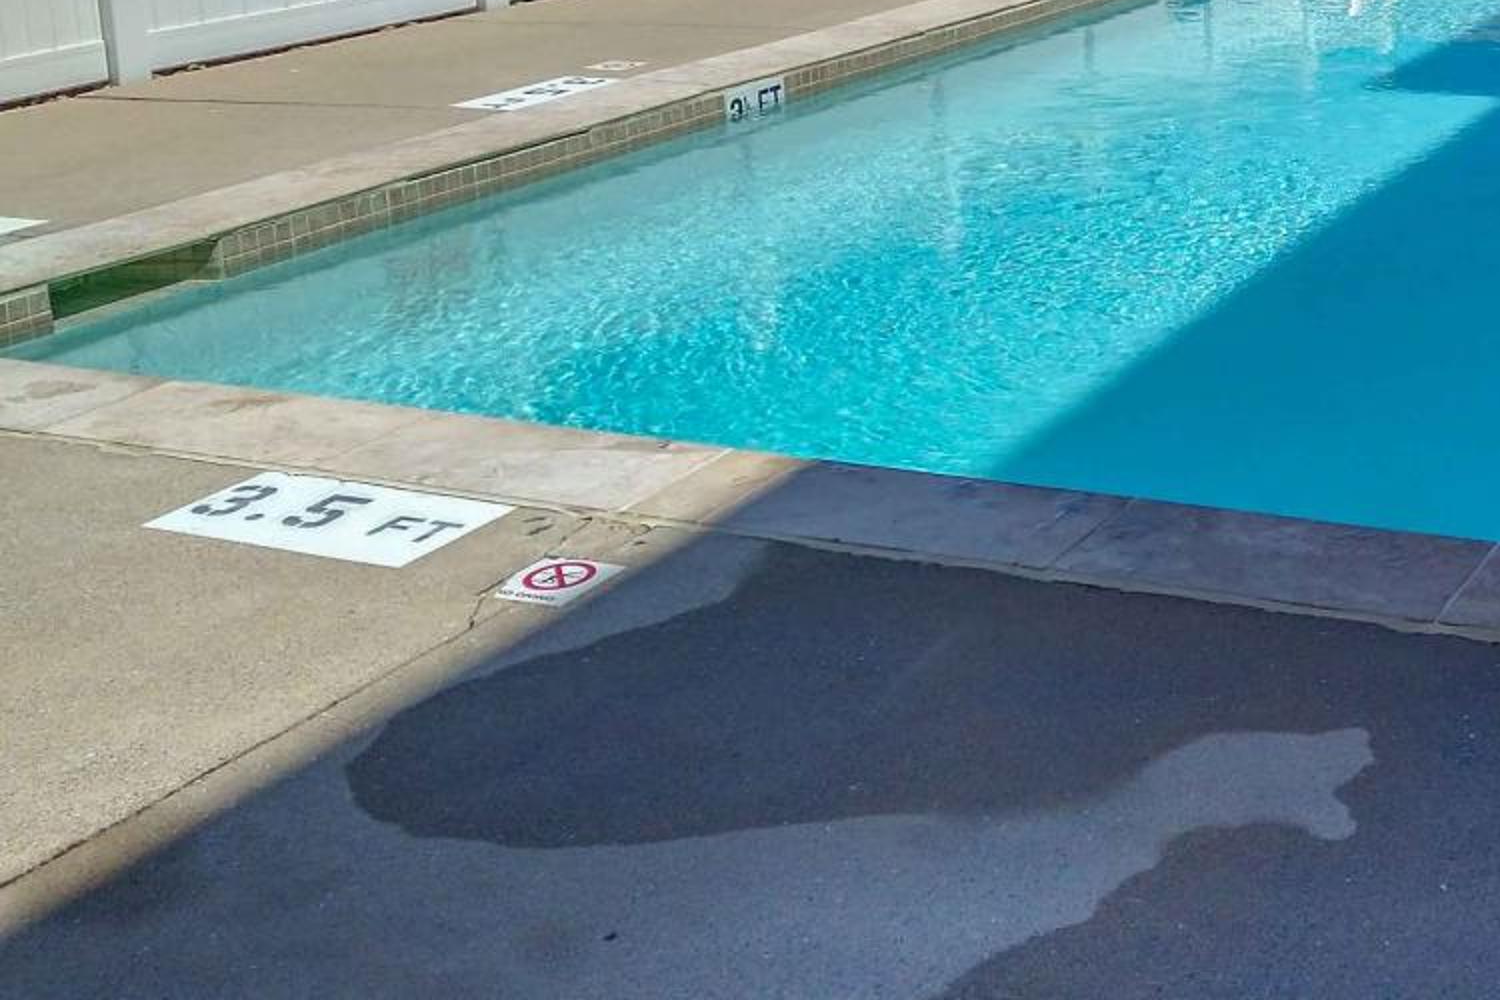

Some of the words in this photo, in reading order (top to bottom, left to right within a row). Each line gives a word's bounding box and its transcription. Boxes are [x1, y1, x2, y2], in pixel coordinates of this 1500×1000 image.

[757, 84, 782, 112] FT
[191, 484, 375, 530] 3.5
[365, 516, 466, 544] FT
